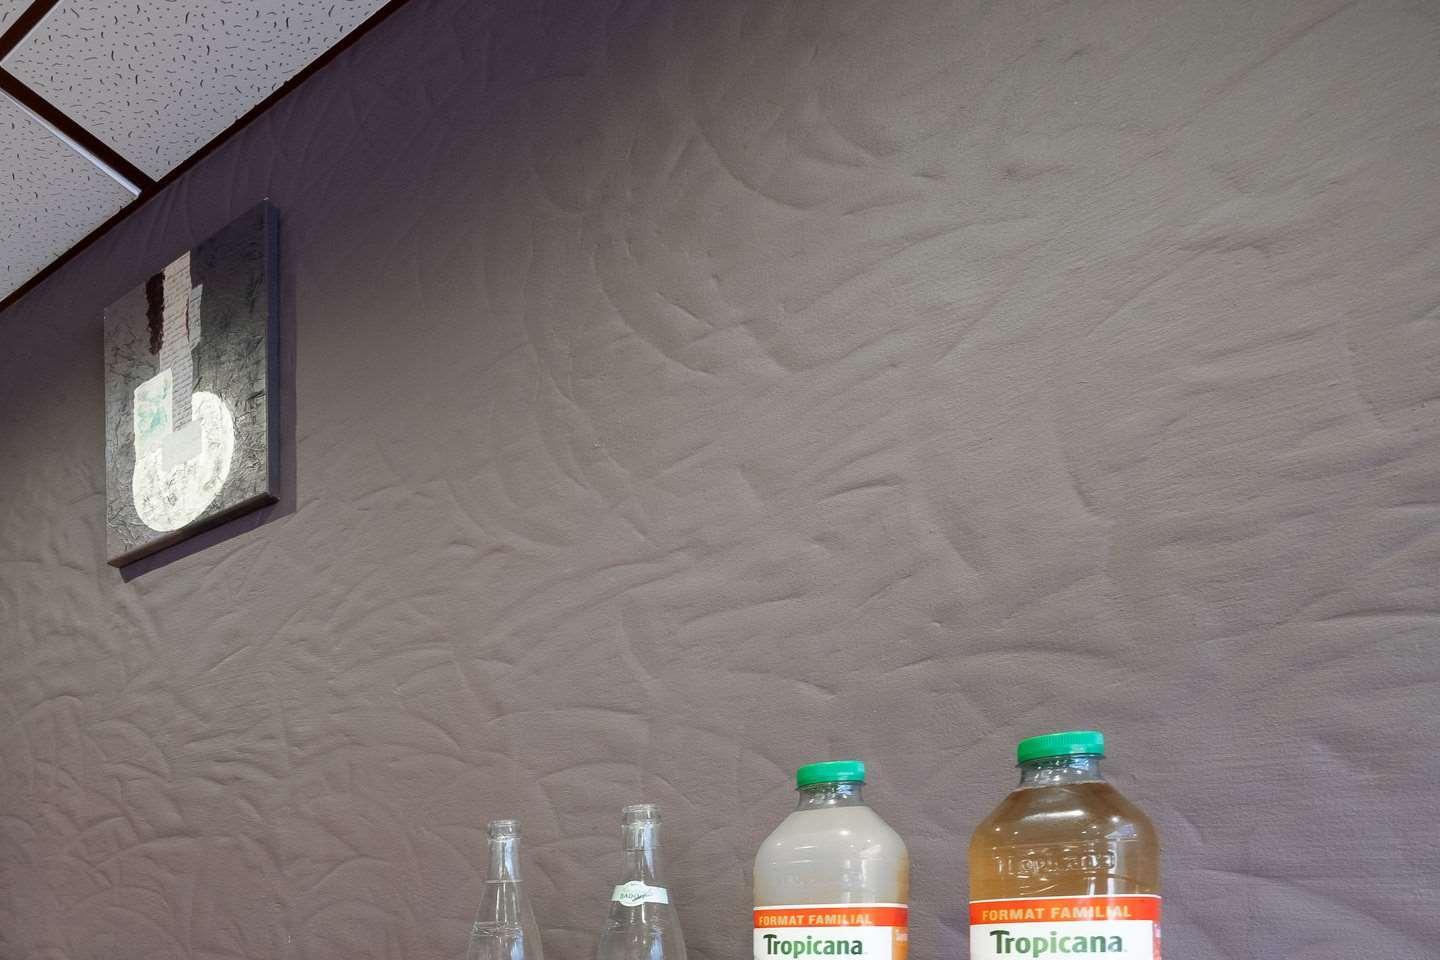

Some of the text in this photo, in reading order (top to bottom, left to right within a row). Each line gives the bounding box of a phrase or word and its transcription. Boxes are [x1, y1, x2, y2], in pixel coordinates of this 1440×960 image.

[758, 913, 873, 927] FORMAT FAMILIAL
[981, 905, 1132, 921] FORMAT FAMILIAL
[762, 933, 864, 959] Tropicana
[989, 929, 1124, 958] Tropicana
